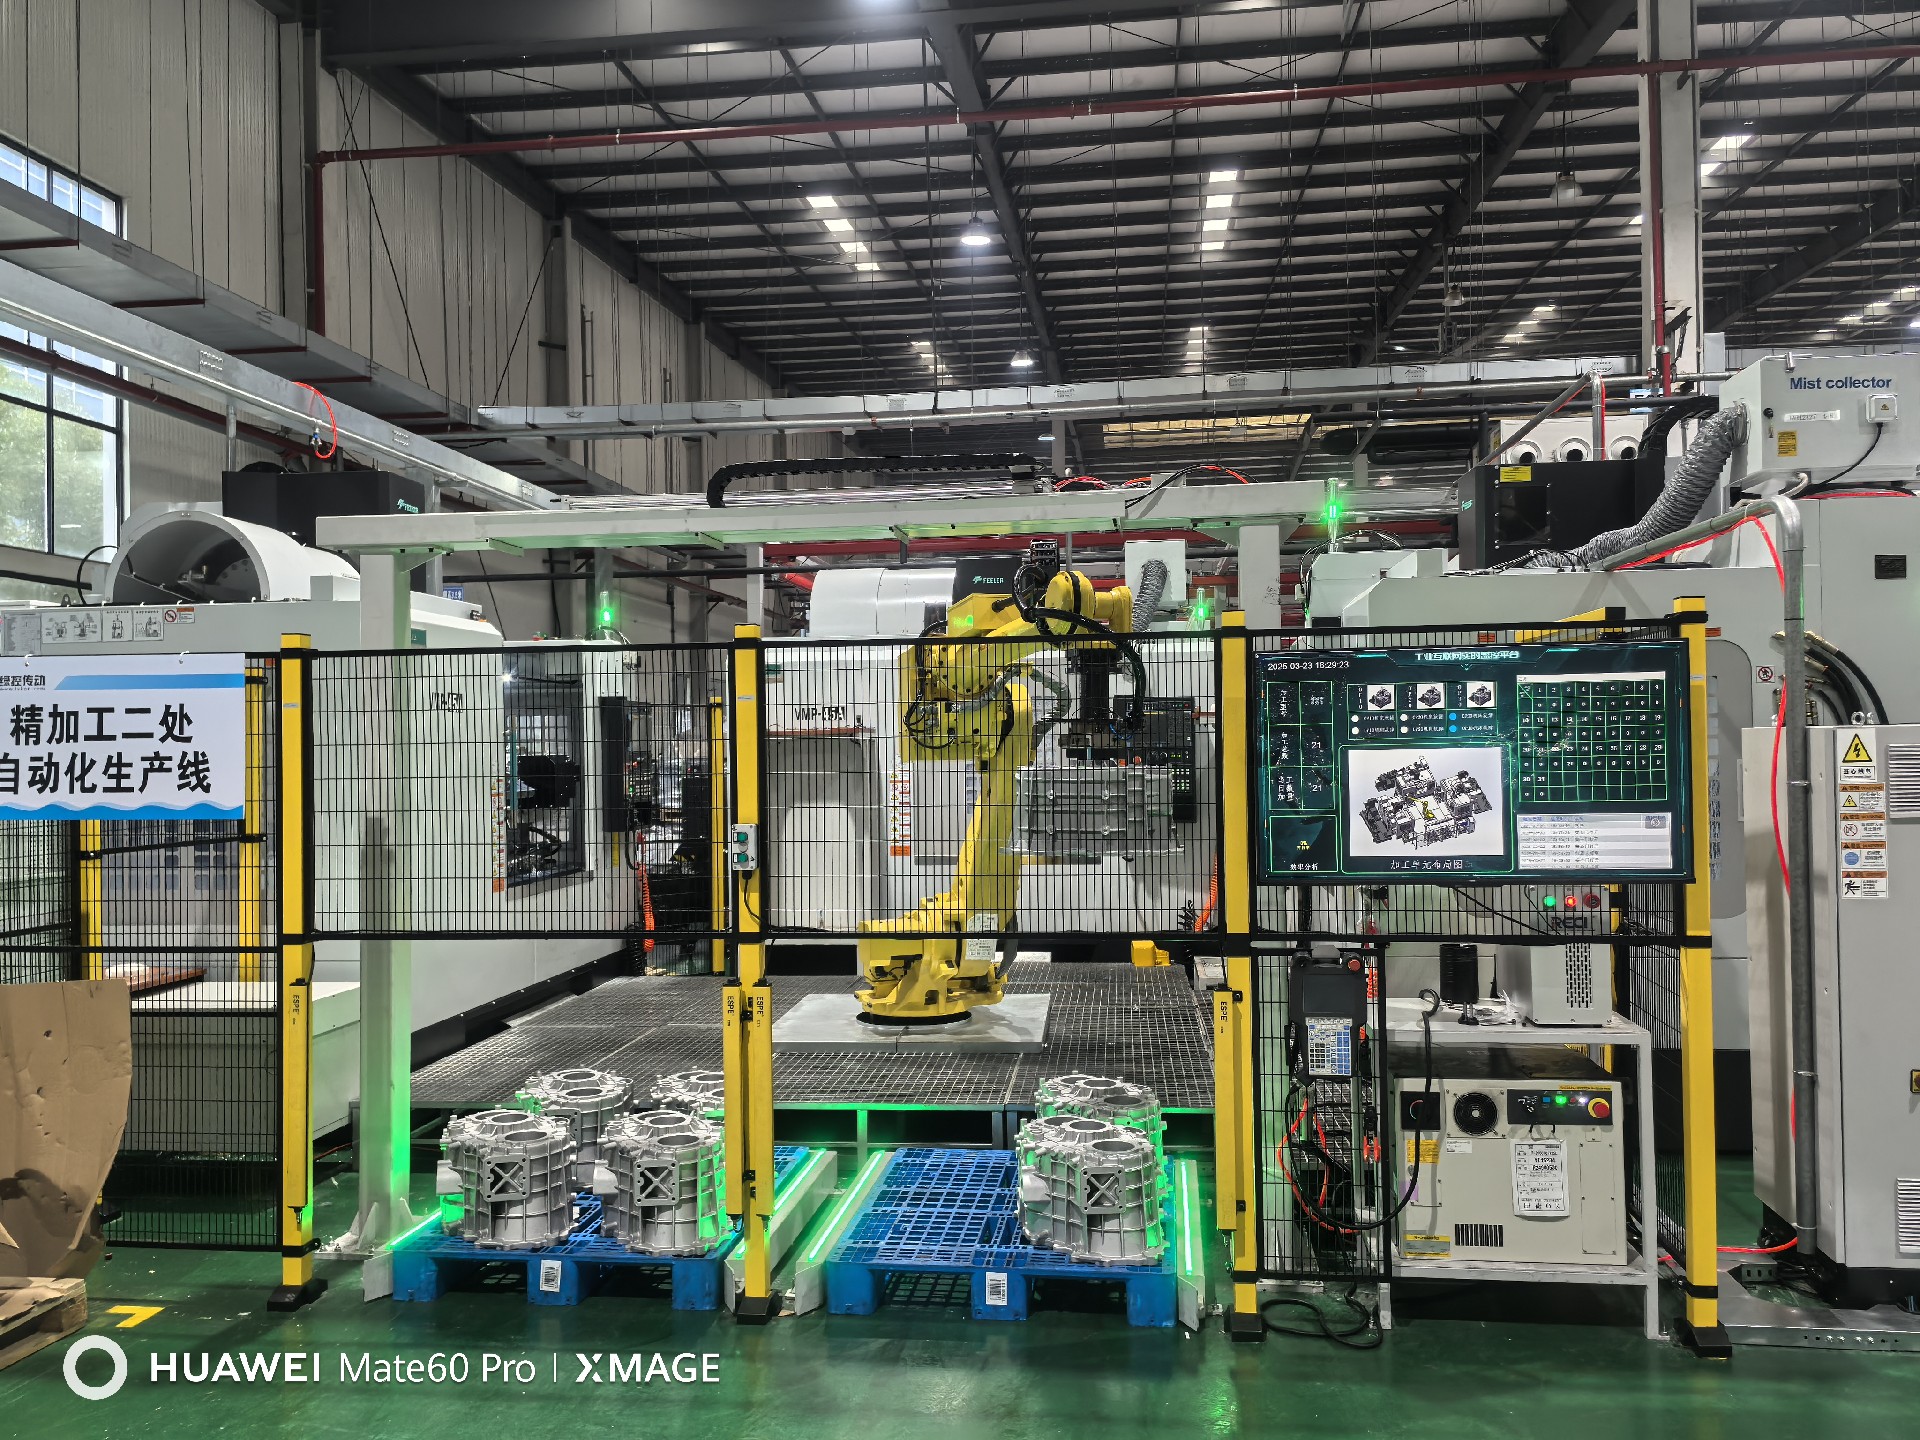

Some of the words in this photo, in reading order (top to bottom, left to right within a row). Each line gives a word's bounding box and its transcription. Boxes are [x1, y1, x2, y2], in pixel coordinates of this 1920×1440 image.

[1790, 377, 1822, 390] Mist
[1826, 376, 1892, 389] collector
[10, 703, 194, 746] 精加工二处
[0, 750, 212, 795] 自动化生产线
[1551, 916, 1588, 928] RECI
